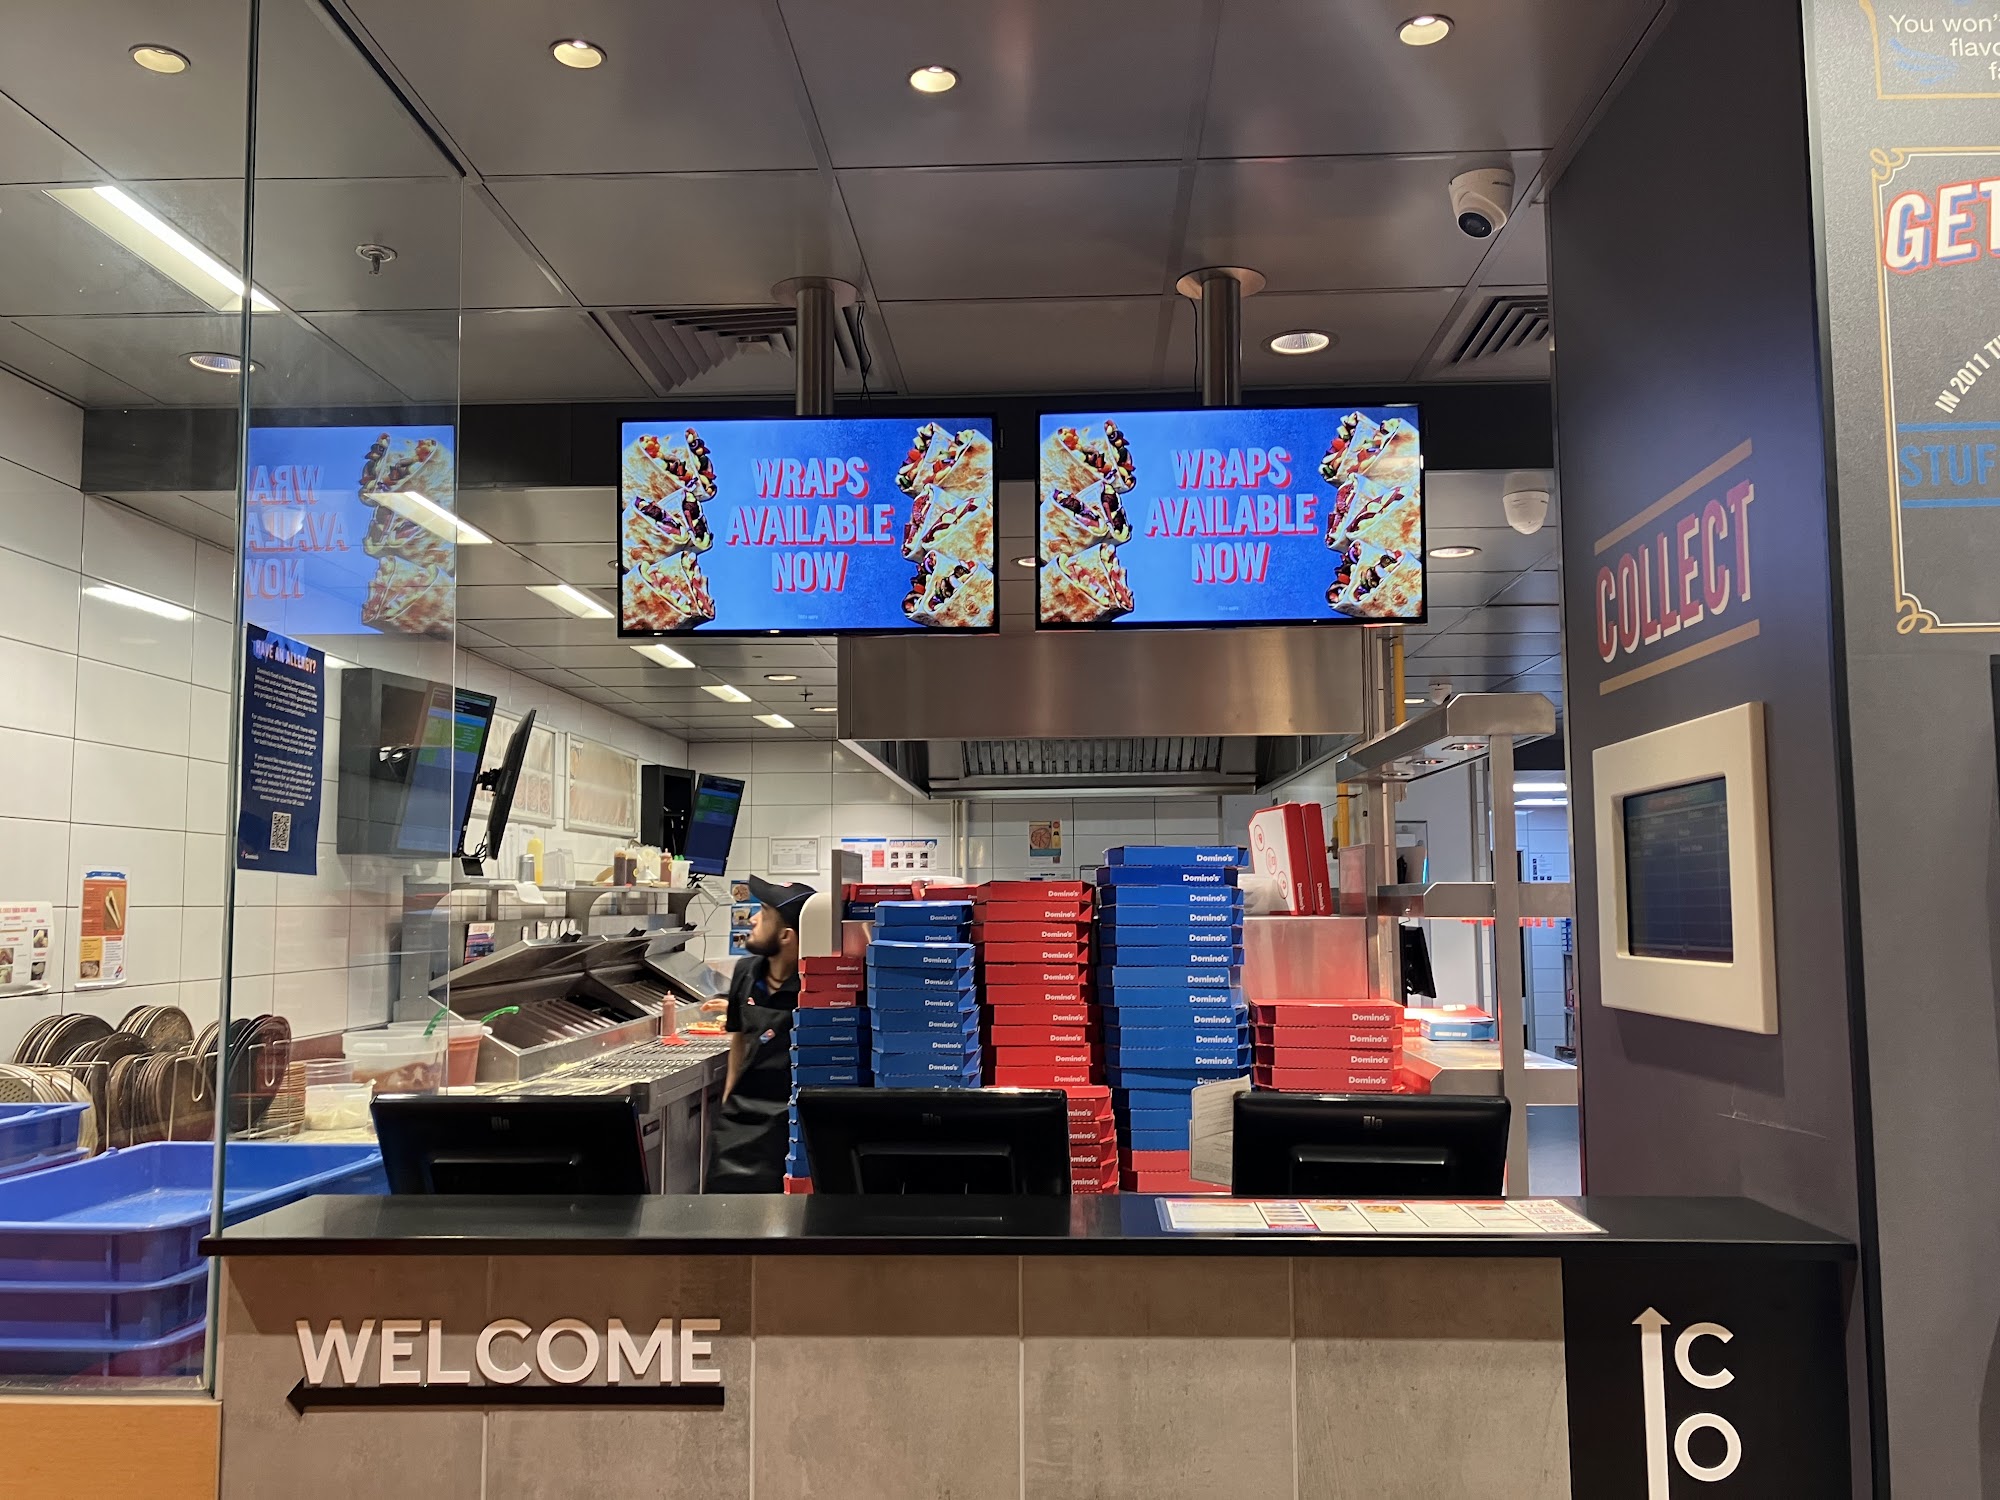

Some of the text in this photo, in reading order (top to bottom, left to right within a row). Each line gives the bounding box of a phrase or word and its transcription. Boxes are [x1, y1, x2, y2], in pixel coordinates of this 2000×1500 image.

[1889, 13, 2000, 33] You won'
[1935, 389, 1960, 414] IN
[1950, 353, 1990, 395] 2011
[1171, 446, 1291, 488] WRAPS
[1900, 444, 1997, 487] STUF
[751, 457, 869, 498] WRAPS
[1145, 493, 1318, 536] AVAILABLE
[726, 503, 894, 545] AVAILABLE
[1191, 542, 1270, 583] NOW
[771, 552, 848, 592] NOW
[1596, 479, 1755, 663] COLLECT
[1196, 854, 1234, 862] Domino's
[1183, 874, 1221, 882] Domino's
[1190, 894, 1228, 902] Domino's
[1297, 883, 1305, 911] Domino's
[1317, 883, 1325, 911] Domino's
[1190, 914, 1228, 922] Domino's
[1189, 934, 1228, 942] Domino's
[1191, 954, 1229, 962] Domino's
[1188, 975, 1226, 983] Domino's
[1045, 993, 1077, 1001] Domino's
[1189, 995, 1228, 1003] Domino's
[1194, 1015, 1232, 1023] Domino's
[1352, 1014, 1391, 1022] Domino's
[1196, 1035, 1234, 1043] Domino's
[1350, 1035, 1389, 1043] Domino's
[1195, 1056, 1234, 1065] Domino's
[1351, 1056, 1390, 1064] Domino's
[1054, 1075, 1087, 1083] Domino's
[1349, 1076, 1388, 1084] Domino's
[1068, 1109, 1093, 1117] mino's
[1070, 1131, 1097, 1139] omino's
[1070, 1155, 1098, 1163] omino's
[1072, 1178, 1099, 1186] omino's
[296, 1318, 721, 1385] WELCOME
